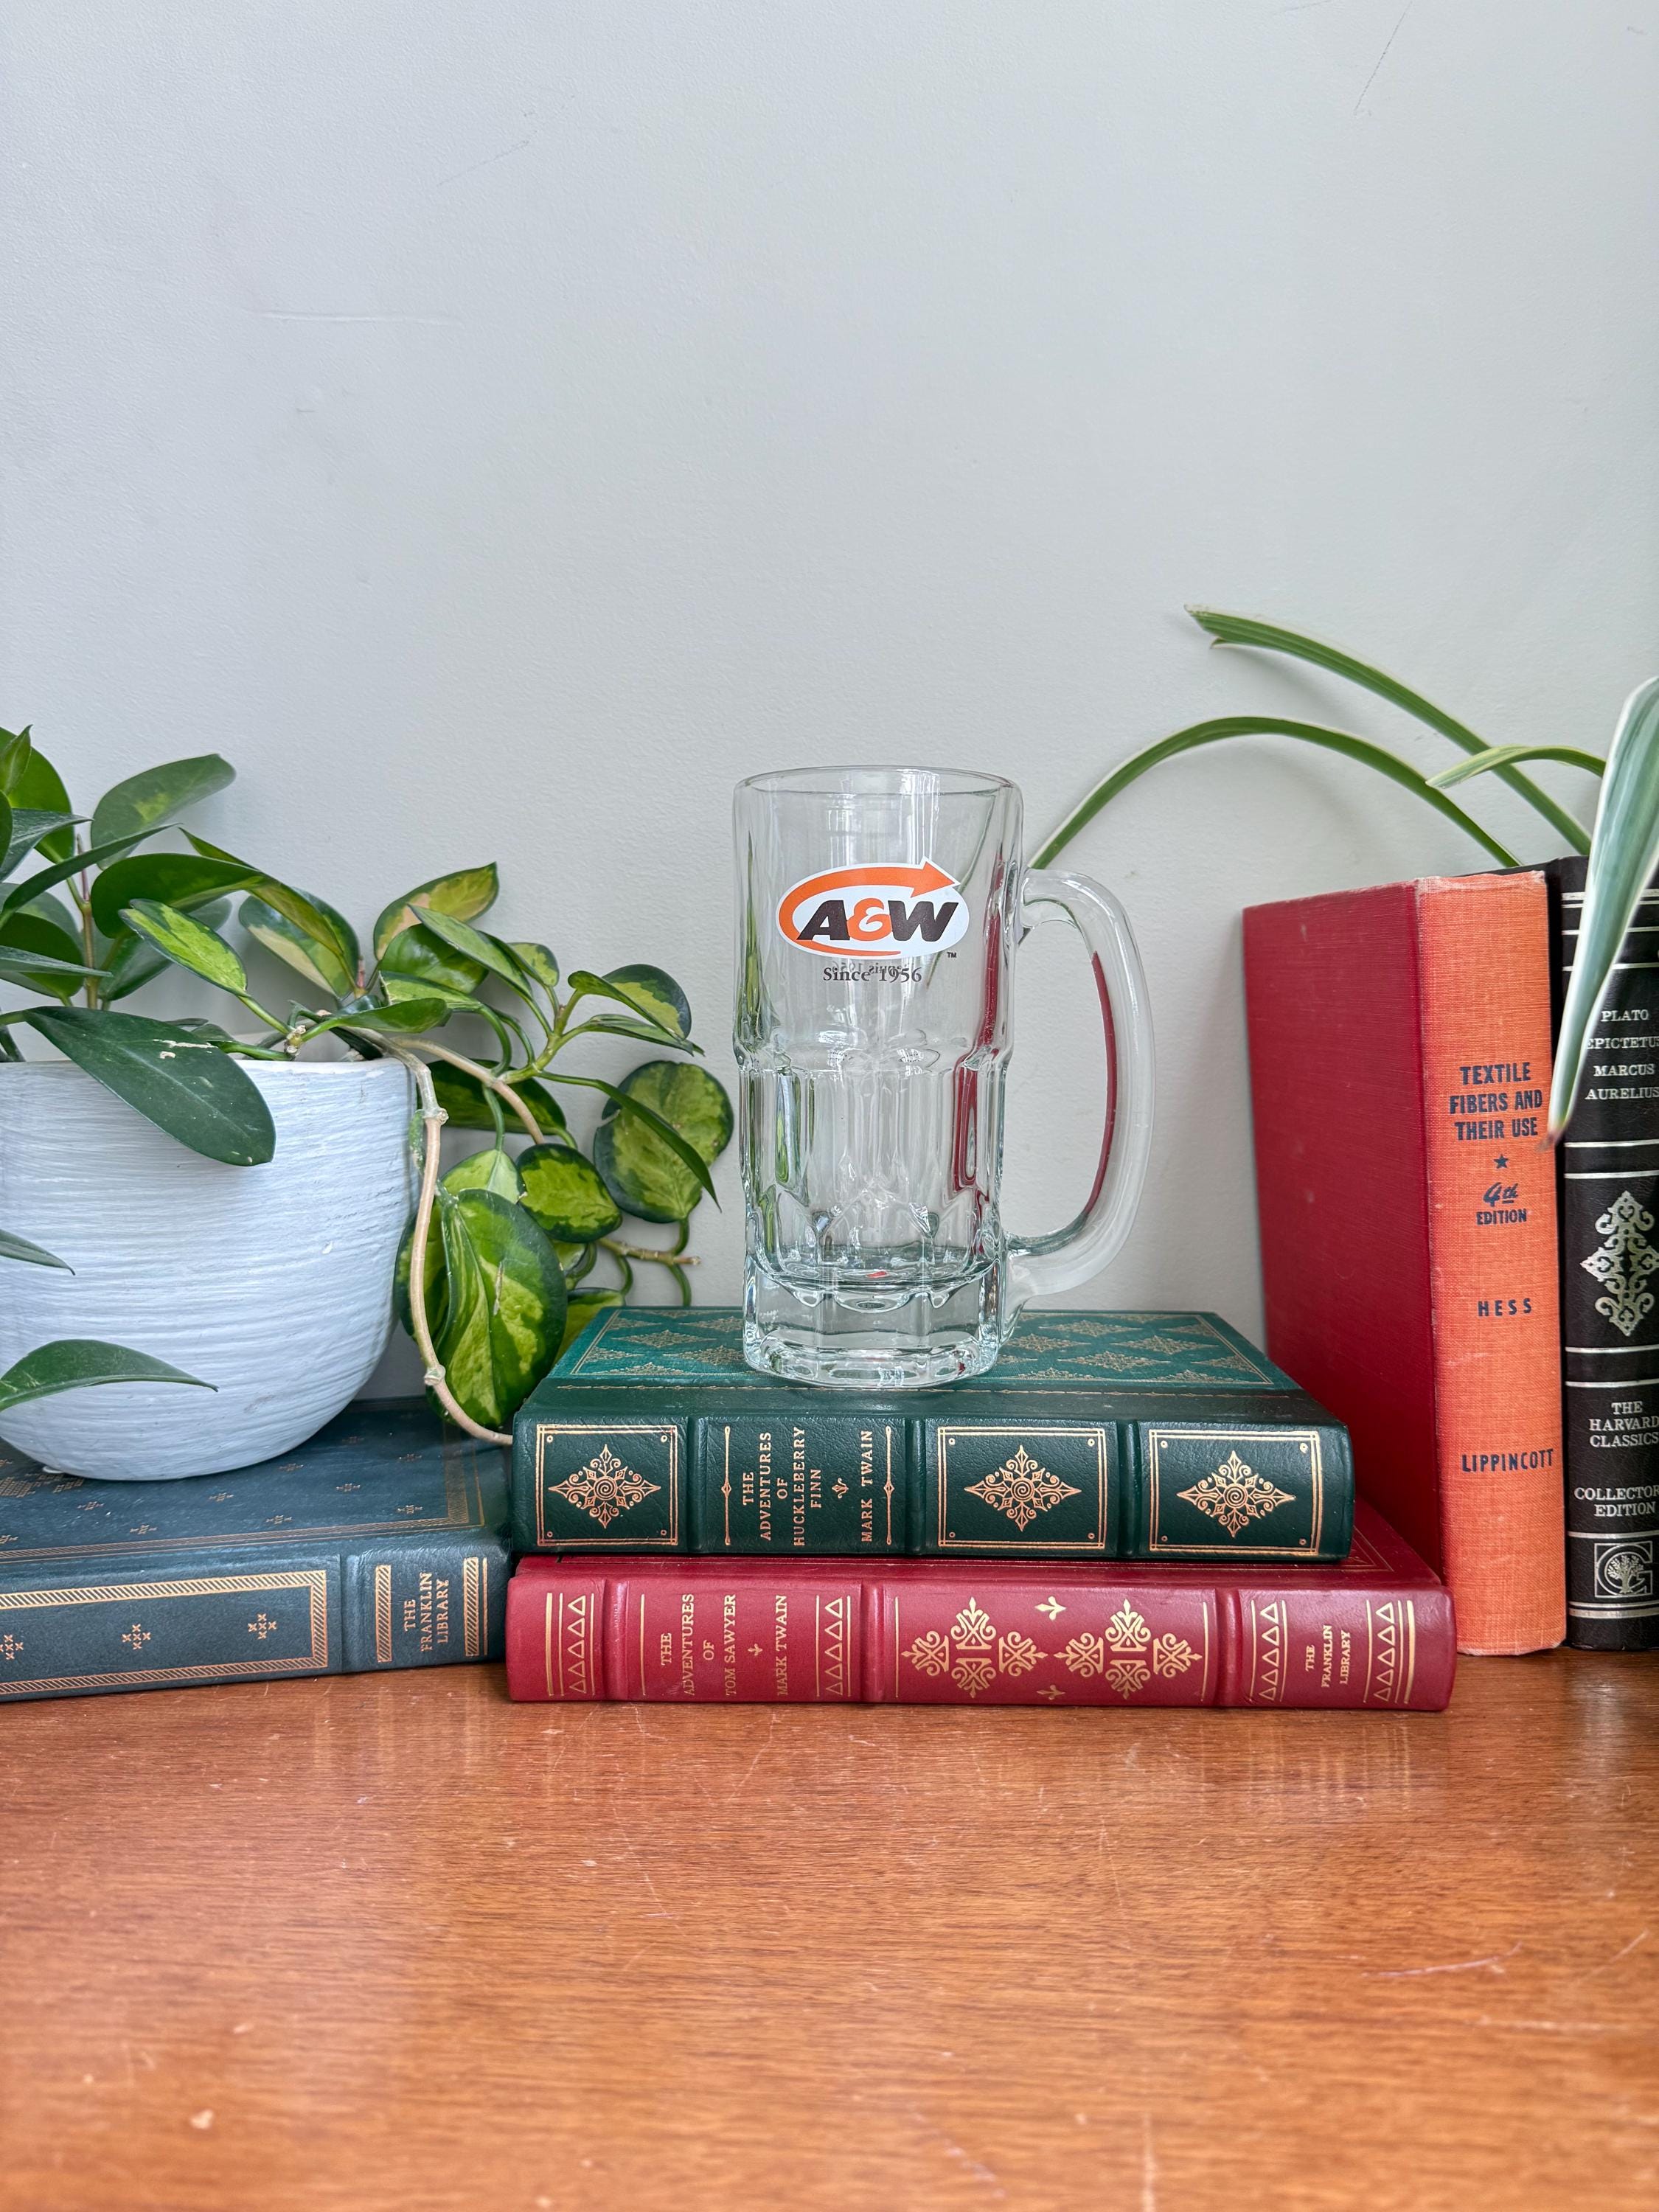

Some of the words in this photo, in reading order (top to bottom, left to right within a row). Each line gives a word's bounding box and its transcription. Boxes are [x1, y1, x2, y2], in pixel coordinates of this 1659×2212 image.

[796, 897, 959, 942] A&W
[823, 967, 871, 981] Since
[879, 967, 922, 983] 1956
[1601, 1009, 1649, 1022] PLATO
[1459, 1062, 1531, 1085] TEXTILE
[1593, 1063, 1655, 1077] MARCUS
[1449, 1093, 1508, 1115] FIBERS
[1514, 1089, 1543, 1111] AND
[1585, 1086, 1659, 1100] AURELIUS
[1454, 1119, 1505, 1141] THEIR
[1512, 1116, 1538, 1138] USE
[1483, 1182, 1519, 1207] 4th
[1476, 1208, 1527, 1225] EDITION
[1478, 1298, 1532, 1317] HESS
[1611, 1401, 1643, 1415] THE
[1588, 1415, 1659, 1431] HARVARD
[1589, 1431, 1659, 1447] CLASSICS
[861, 1430, 873, 1486] TWAIN
[1461, 1448, 1554, 1473] LIPPINCOTT
[742, 1471, 754, 1506] THE
[759, 1432, 772, 1541] ADVENTURES
[776, 1478, 788, 1499] OF
[793, 1427, 805, 1546] HUCKLEBERRY
[810, 1469, 821, 1509] FINN
[861, 1498, 873, 1542] MARK
[1594, 1501, 1656, 1517] EDITION
[403, 1599, 416, 1632] THE
[419, 1571, 433, 1652] FRANKLIN
[436, 1579, 449, 1644] LIBRARY
[775, 1595, 787, 1651] TWAIN
[724, 1594, 736, 1663] SAWYER
[661, 1632, 672, 1666] THE
[681, 1593, 695, 1696] ADVENTURES
[703, 1640, 714, 1660] OF
[1305, 1644, 1315, 1672] THE
[1321, 1624, 1333, 1688] FRANKLIN
[1339, 1630, 1352, 1684] LIBRARY
[724, 1668, 737, 1696] TOM
[776, 1655, 788, 1696] MARK
